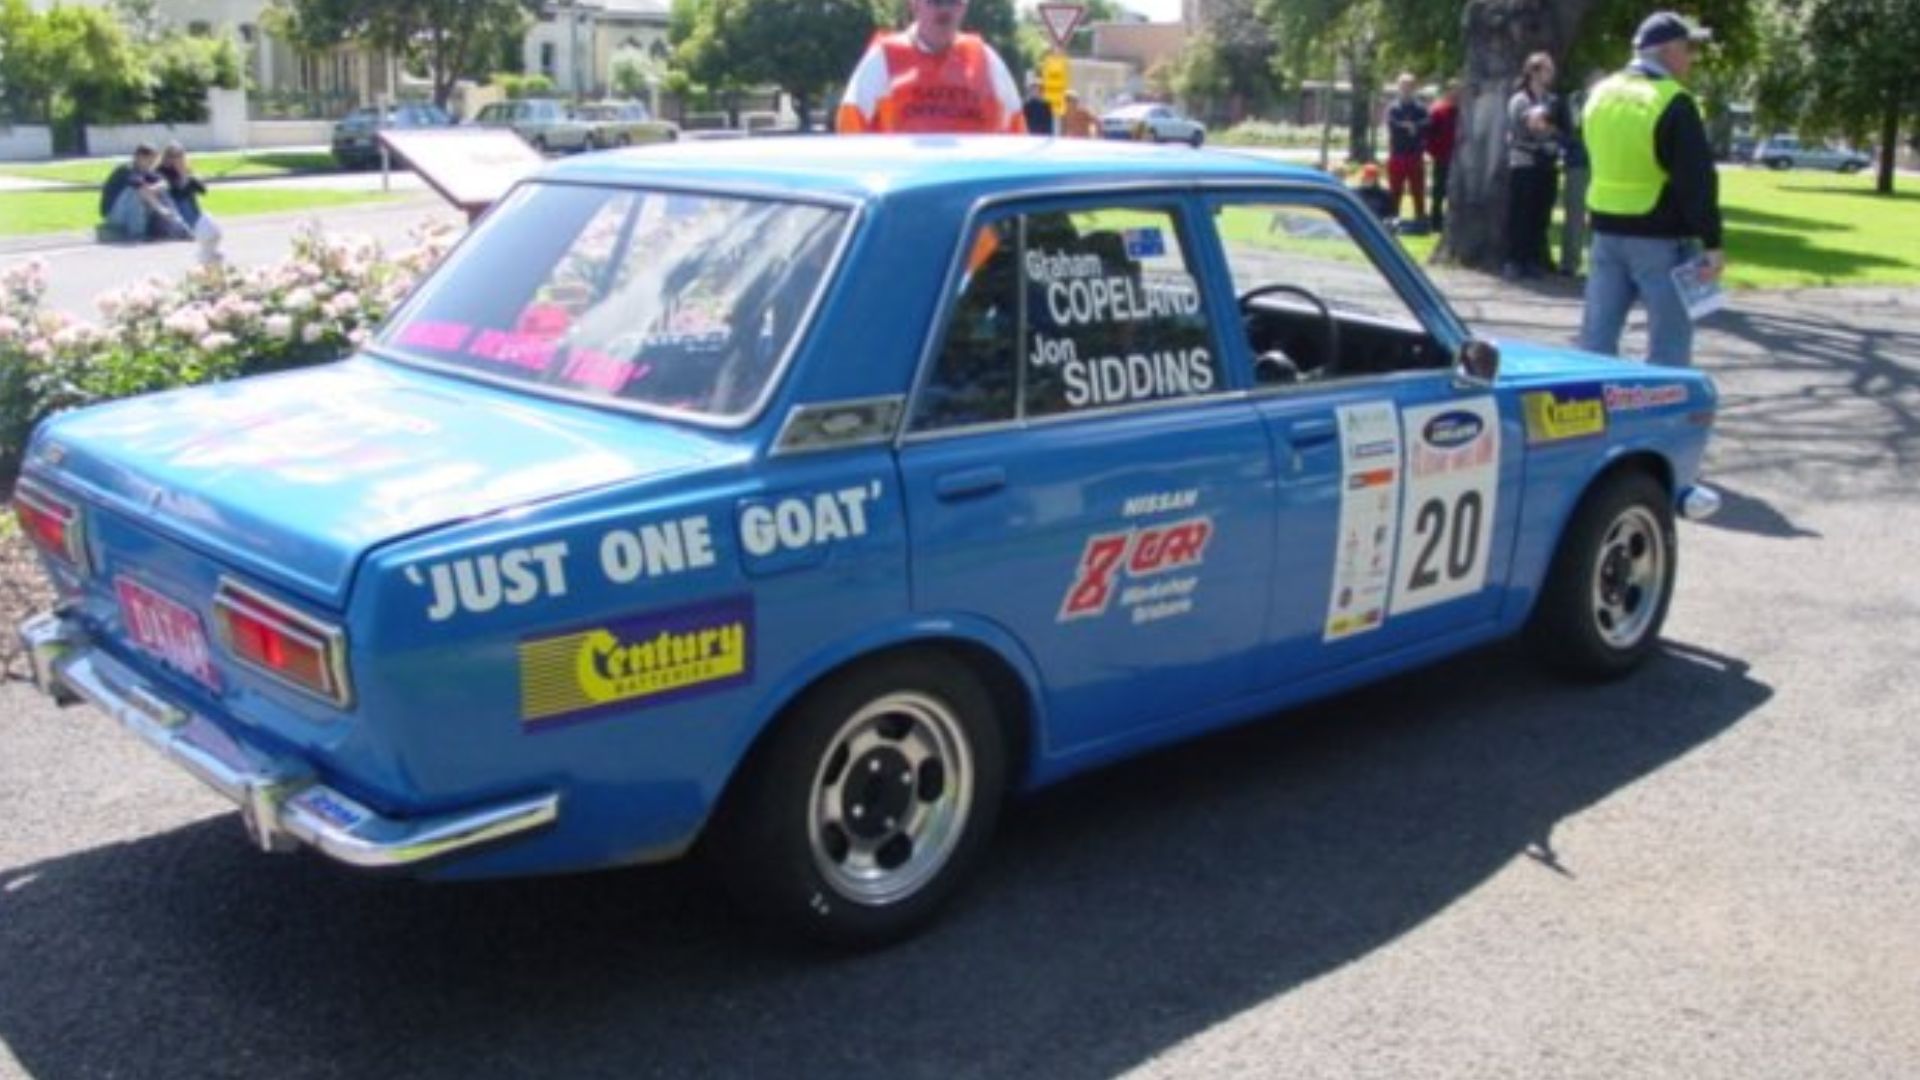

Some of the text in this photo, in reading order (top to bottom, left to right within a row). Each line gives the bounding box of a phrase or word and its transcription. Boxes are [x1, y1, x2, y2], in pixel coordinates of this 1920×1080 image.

[1026, 250, 1101, 280] Graham
[1048, 274, 1200, 324] COPELAND
[1030, 334, 1076, 366] Jon
[1063, 347, 1213, 406] SIDDINS
[600, 516, 716, 584] ONE
[1408, 489, 1482, 591] 20
[578, 622, 744, 702] Century
